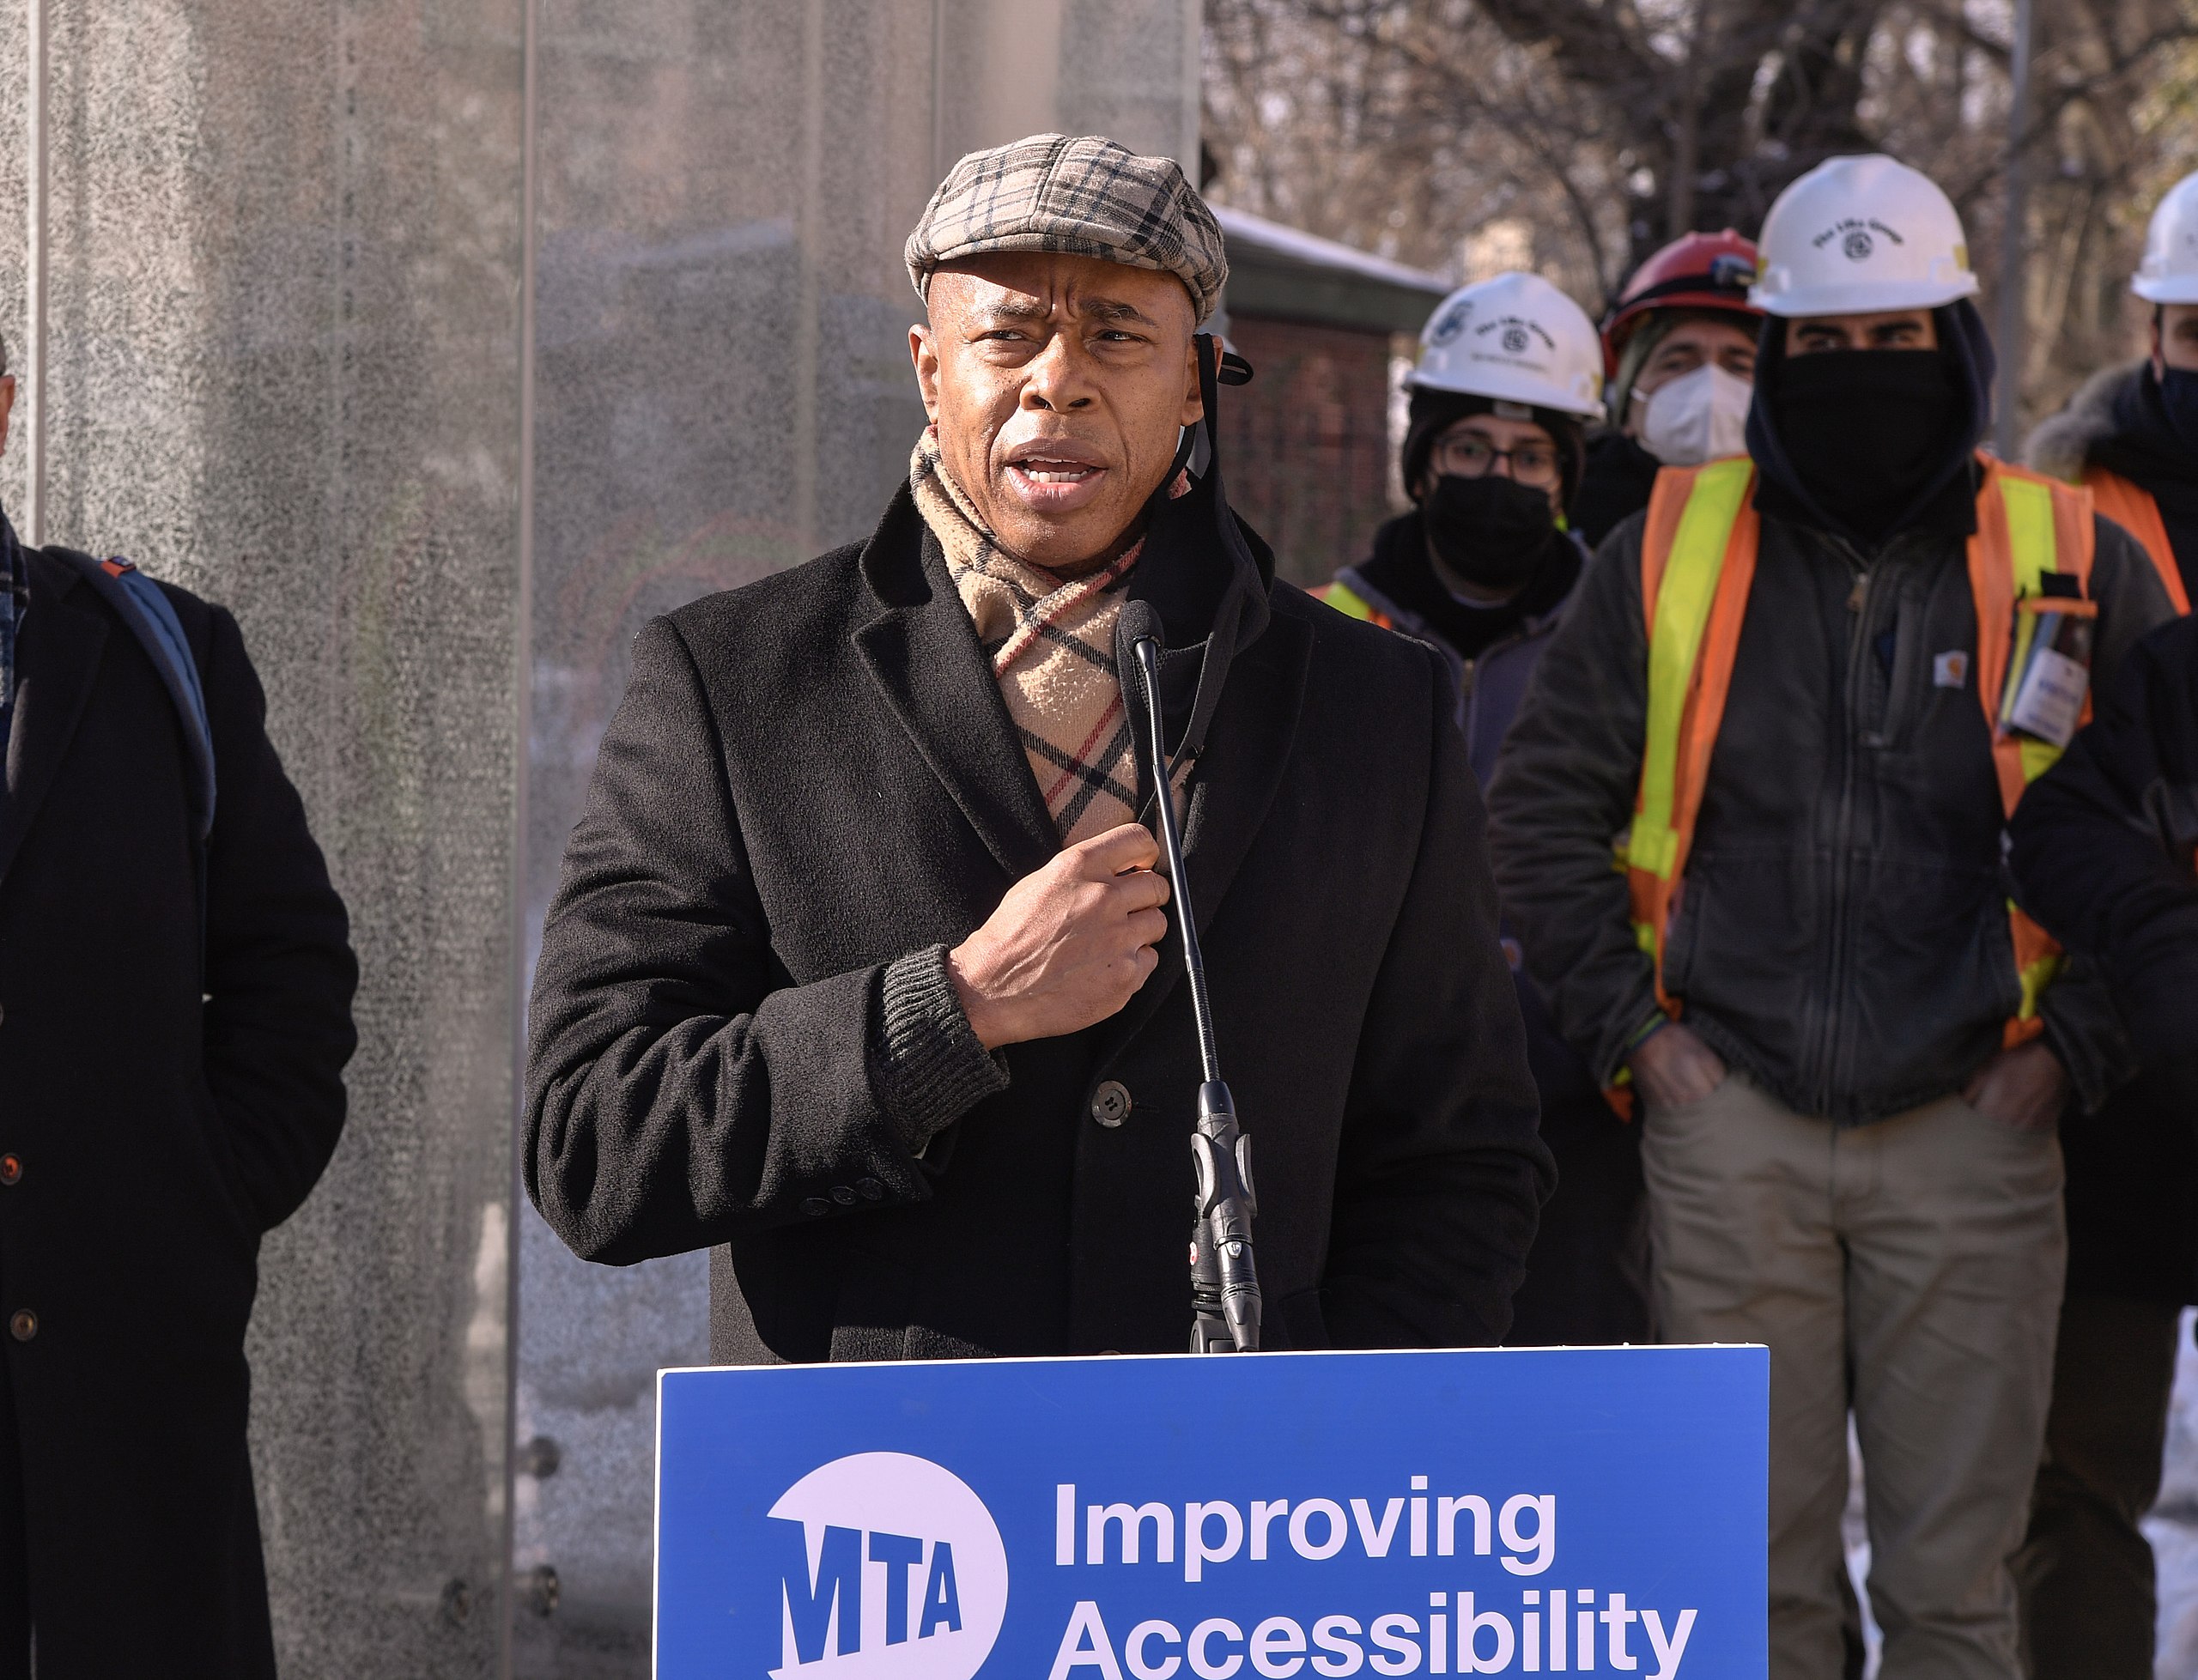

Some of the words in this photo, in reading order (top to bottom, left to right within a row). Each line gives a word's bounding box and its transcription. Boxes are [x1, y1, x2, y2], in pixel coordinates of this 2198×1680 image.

[1055, 1476, 1556, 1583] Improving
[773, 1518, 963, 1671] MTA
[1047, 1590, 1698, 1680] Accessibility
